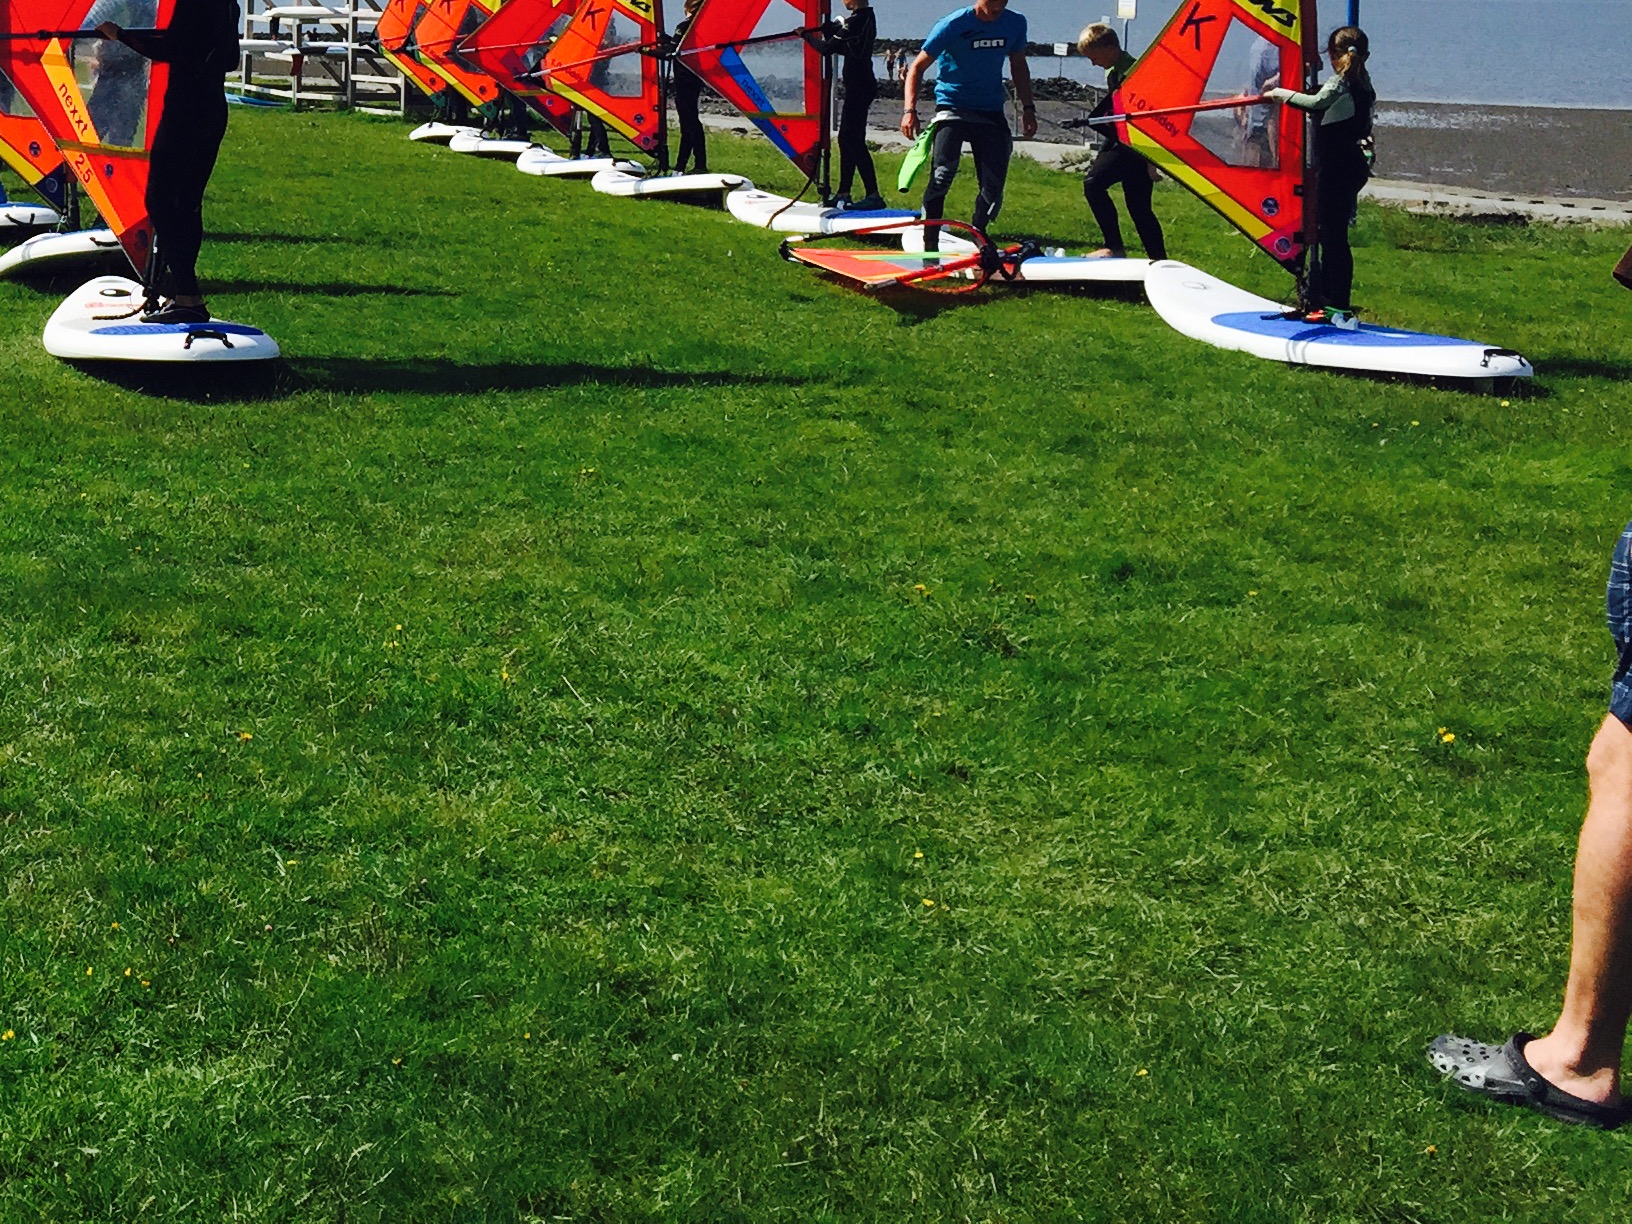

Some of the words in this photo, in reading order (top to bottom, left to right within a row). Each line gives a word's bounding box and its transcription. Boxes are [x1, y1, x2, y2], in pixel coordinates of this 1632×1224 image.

[581, 0, 606, 32] K
[1179, 1, 1217, 51] K
[58, 83, 88, 136] nexxt
[74, 153, 93, 184] 2.5
